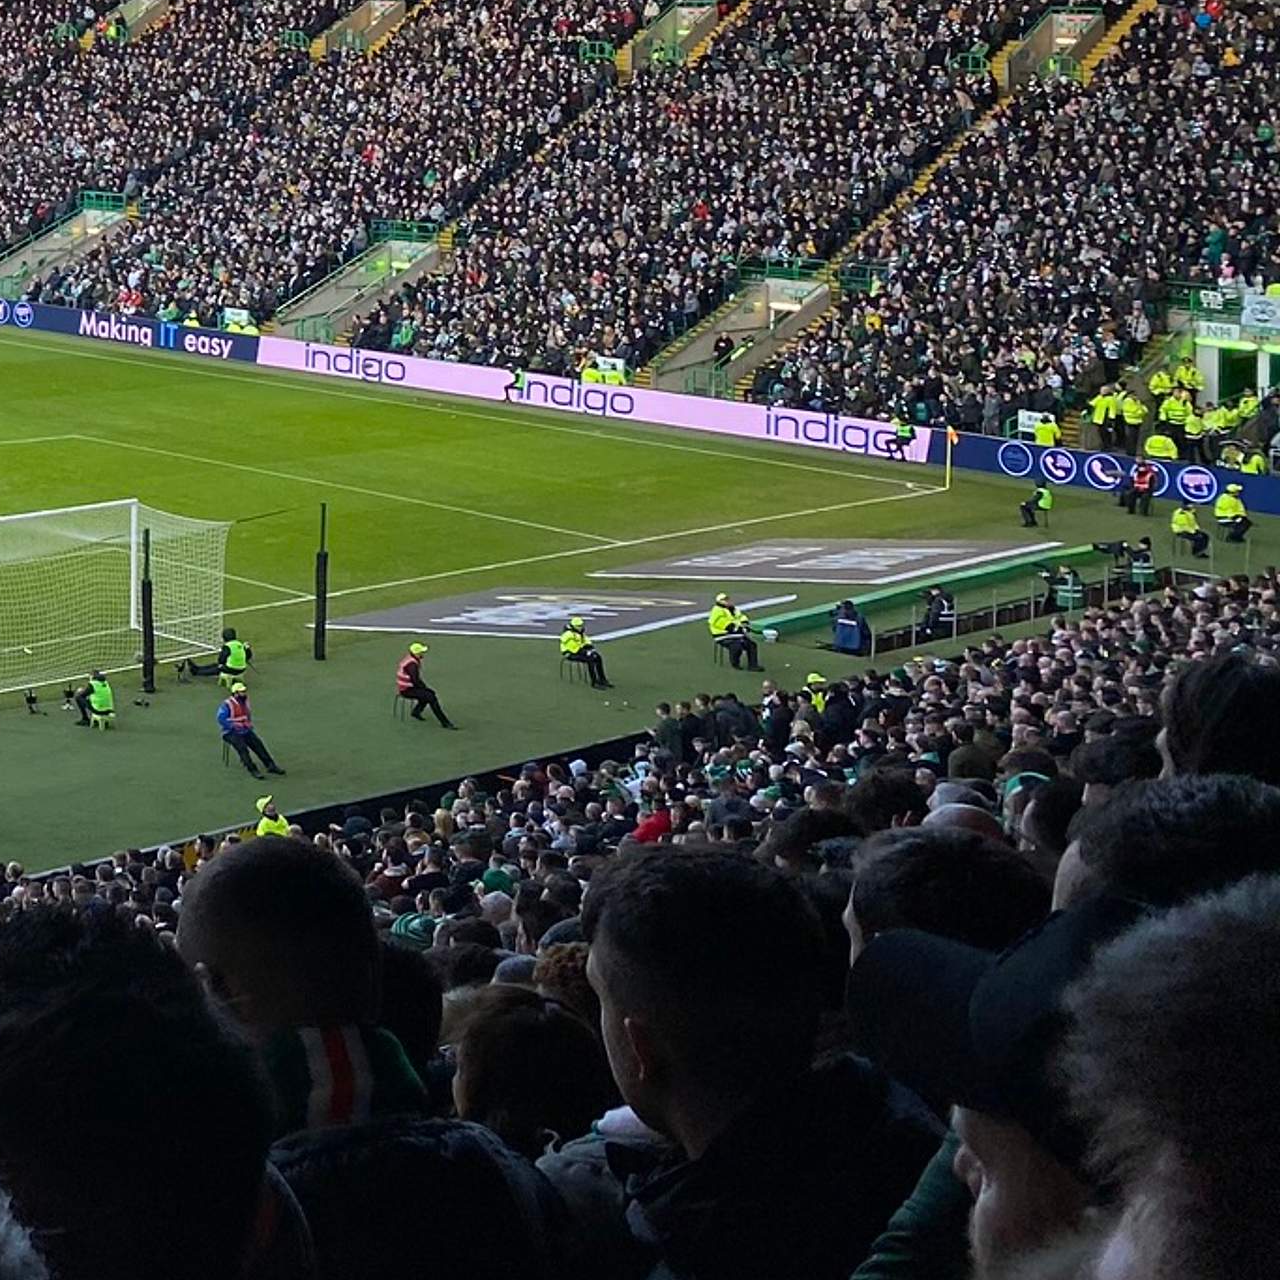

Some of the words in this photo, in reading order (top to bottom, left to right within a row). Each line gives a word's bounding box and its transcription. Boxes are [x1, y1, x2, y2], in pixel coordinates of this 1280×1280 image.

[79, 310, 153, 347] Making
[159, 323, 179, 348] IT
[183, 332, 234, 360] easy
[304, 342, 407, 384] indigo
[766, 406, 905, 455] indigo
